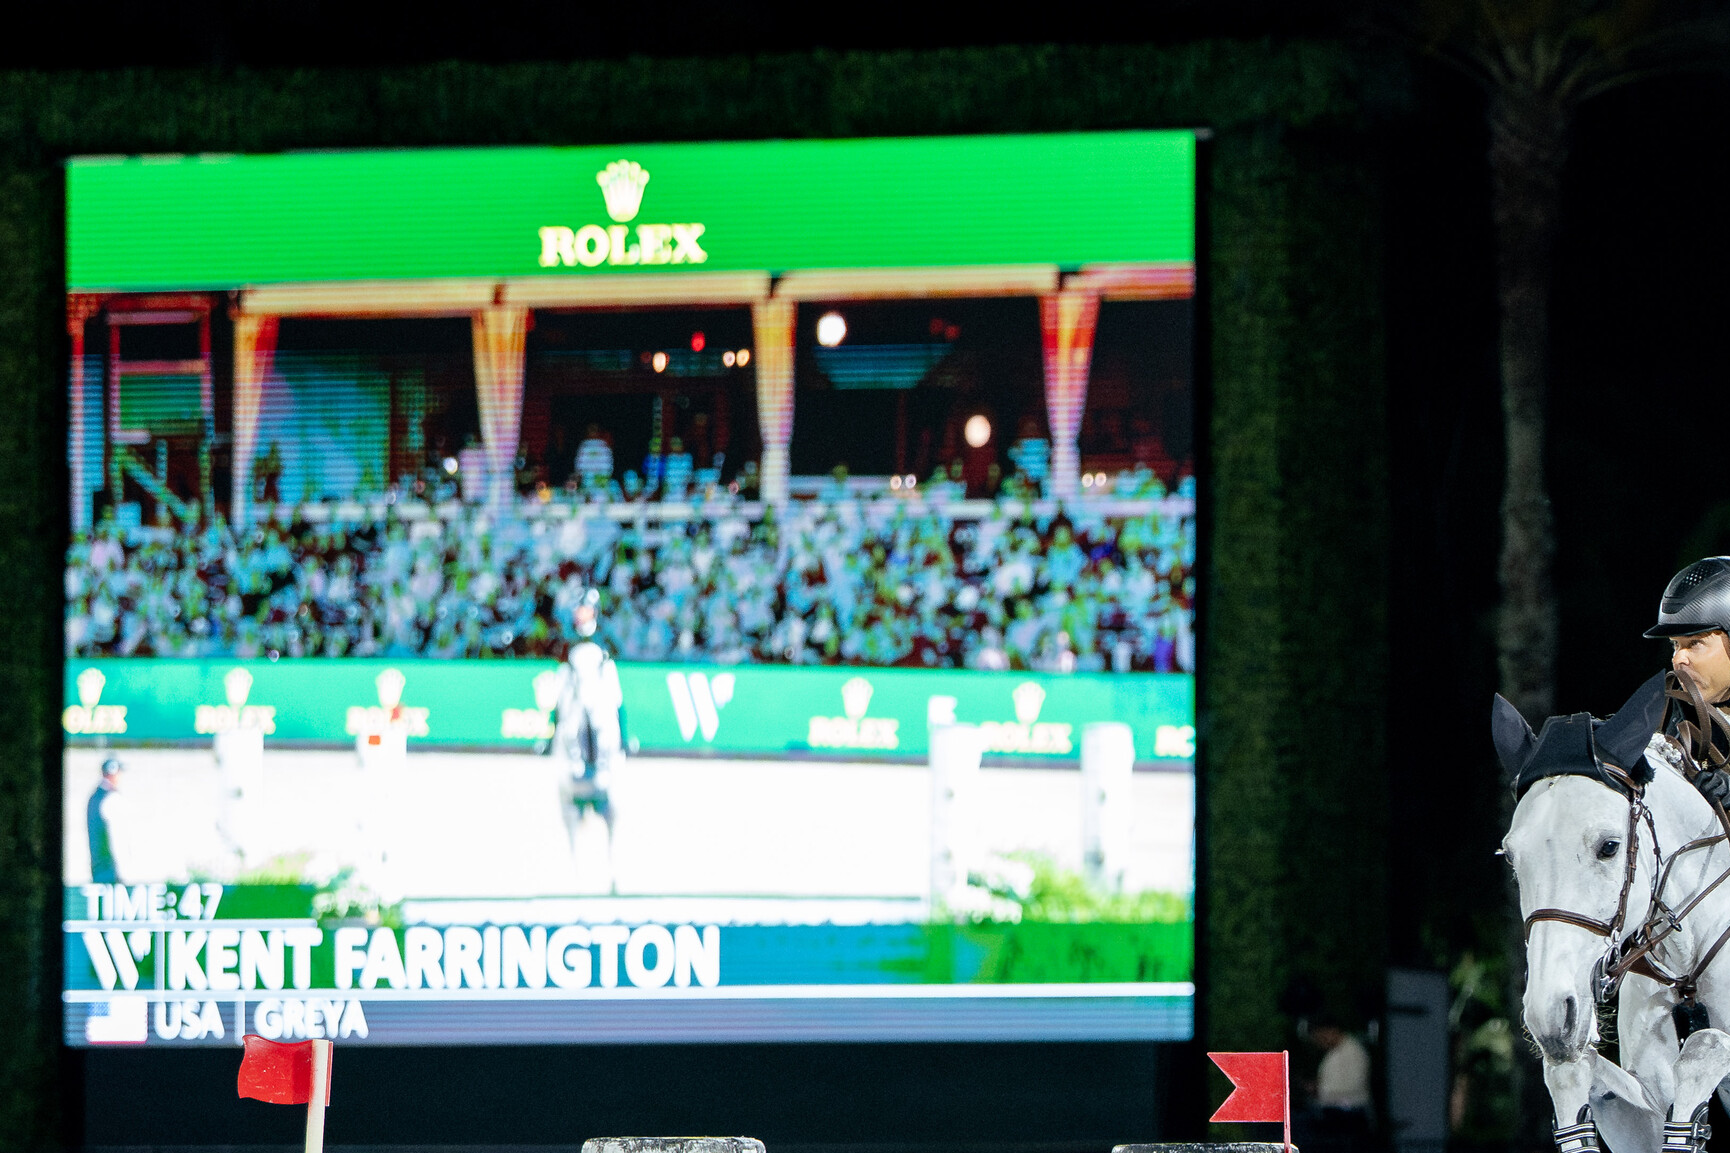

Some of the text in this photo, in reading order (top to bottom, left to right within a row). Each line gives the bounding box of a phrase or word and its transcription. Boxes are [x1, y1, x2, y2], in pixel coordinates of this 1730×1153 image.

[538, 222, 708, 267] ROLEX
[63, 705, 127, 733] OLEX
[502, 708, 556, 738] ROL
[809, 716, 898, 748] ROLEX
[168, 924, 720, 990] KENT FARRINGTON
[154, 1000, 369, 1039] USA GREYA
